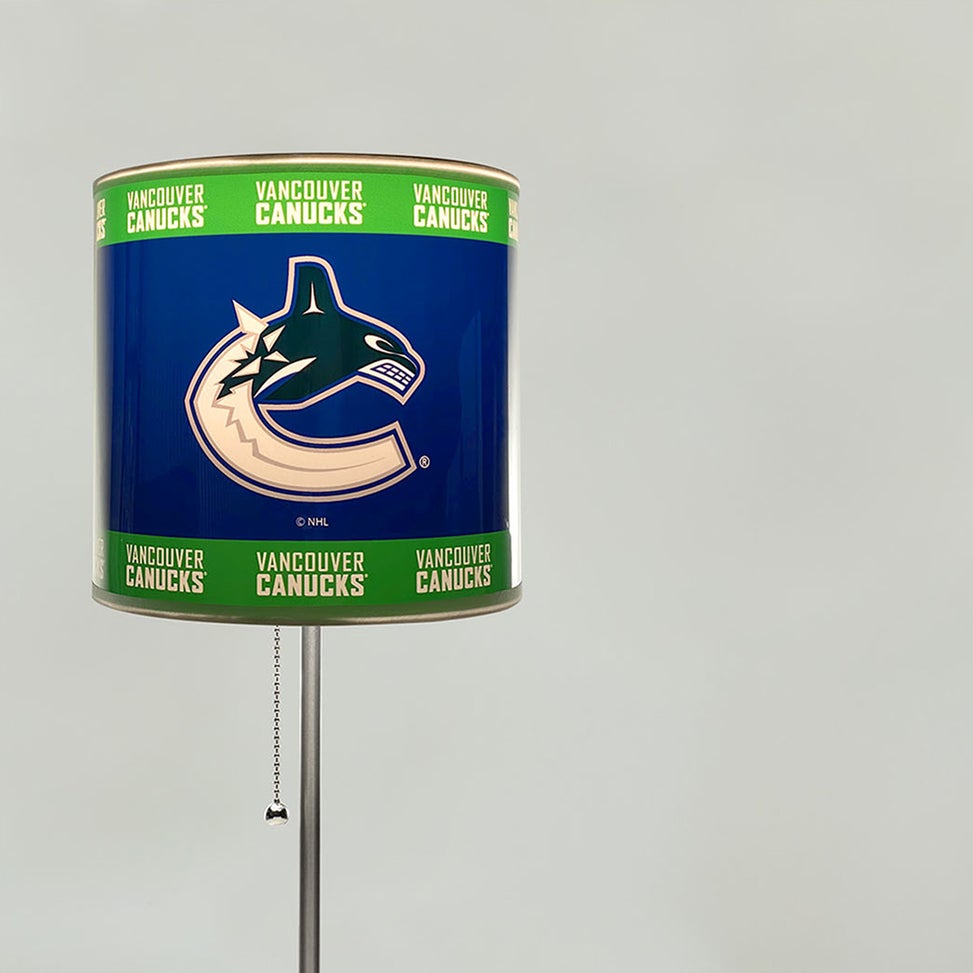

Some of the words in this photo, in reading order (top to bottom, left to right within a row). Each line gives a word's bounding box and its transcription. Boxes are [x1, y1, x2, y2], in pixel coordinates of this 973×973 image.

[127, 183, 204, 211] VANCOUVER
[255, 180, 363, 201] VANCOUVER
[413, 183, 488, 210] VANCOUVER
[126, 205, 205, 234] CANUCKS
[255, 201, 363, 225] CANUCKS
[413, 204, 488, 233] CANUCKS
[307, 517, 329, 527] NHL
[126, 543, 204, 570] VANCOUVER
[256, 551, 364, 572] VANCOUVER
[416, 543, 491, 569] VANCOUVER
[126, 564, 204, 594] CANUCKS
[256, 573, 365, 597] CANUCKS
[416, 564, 492, 594] CANUCKS
